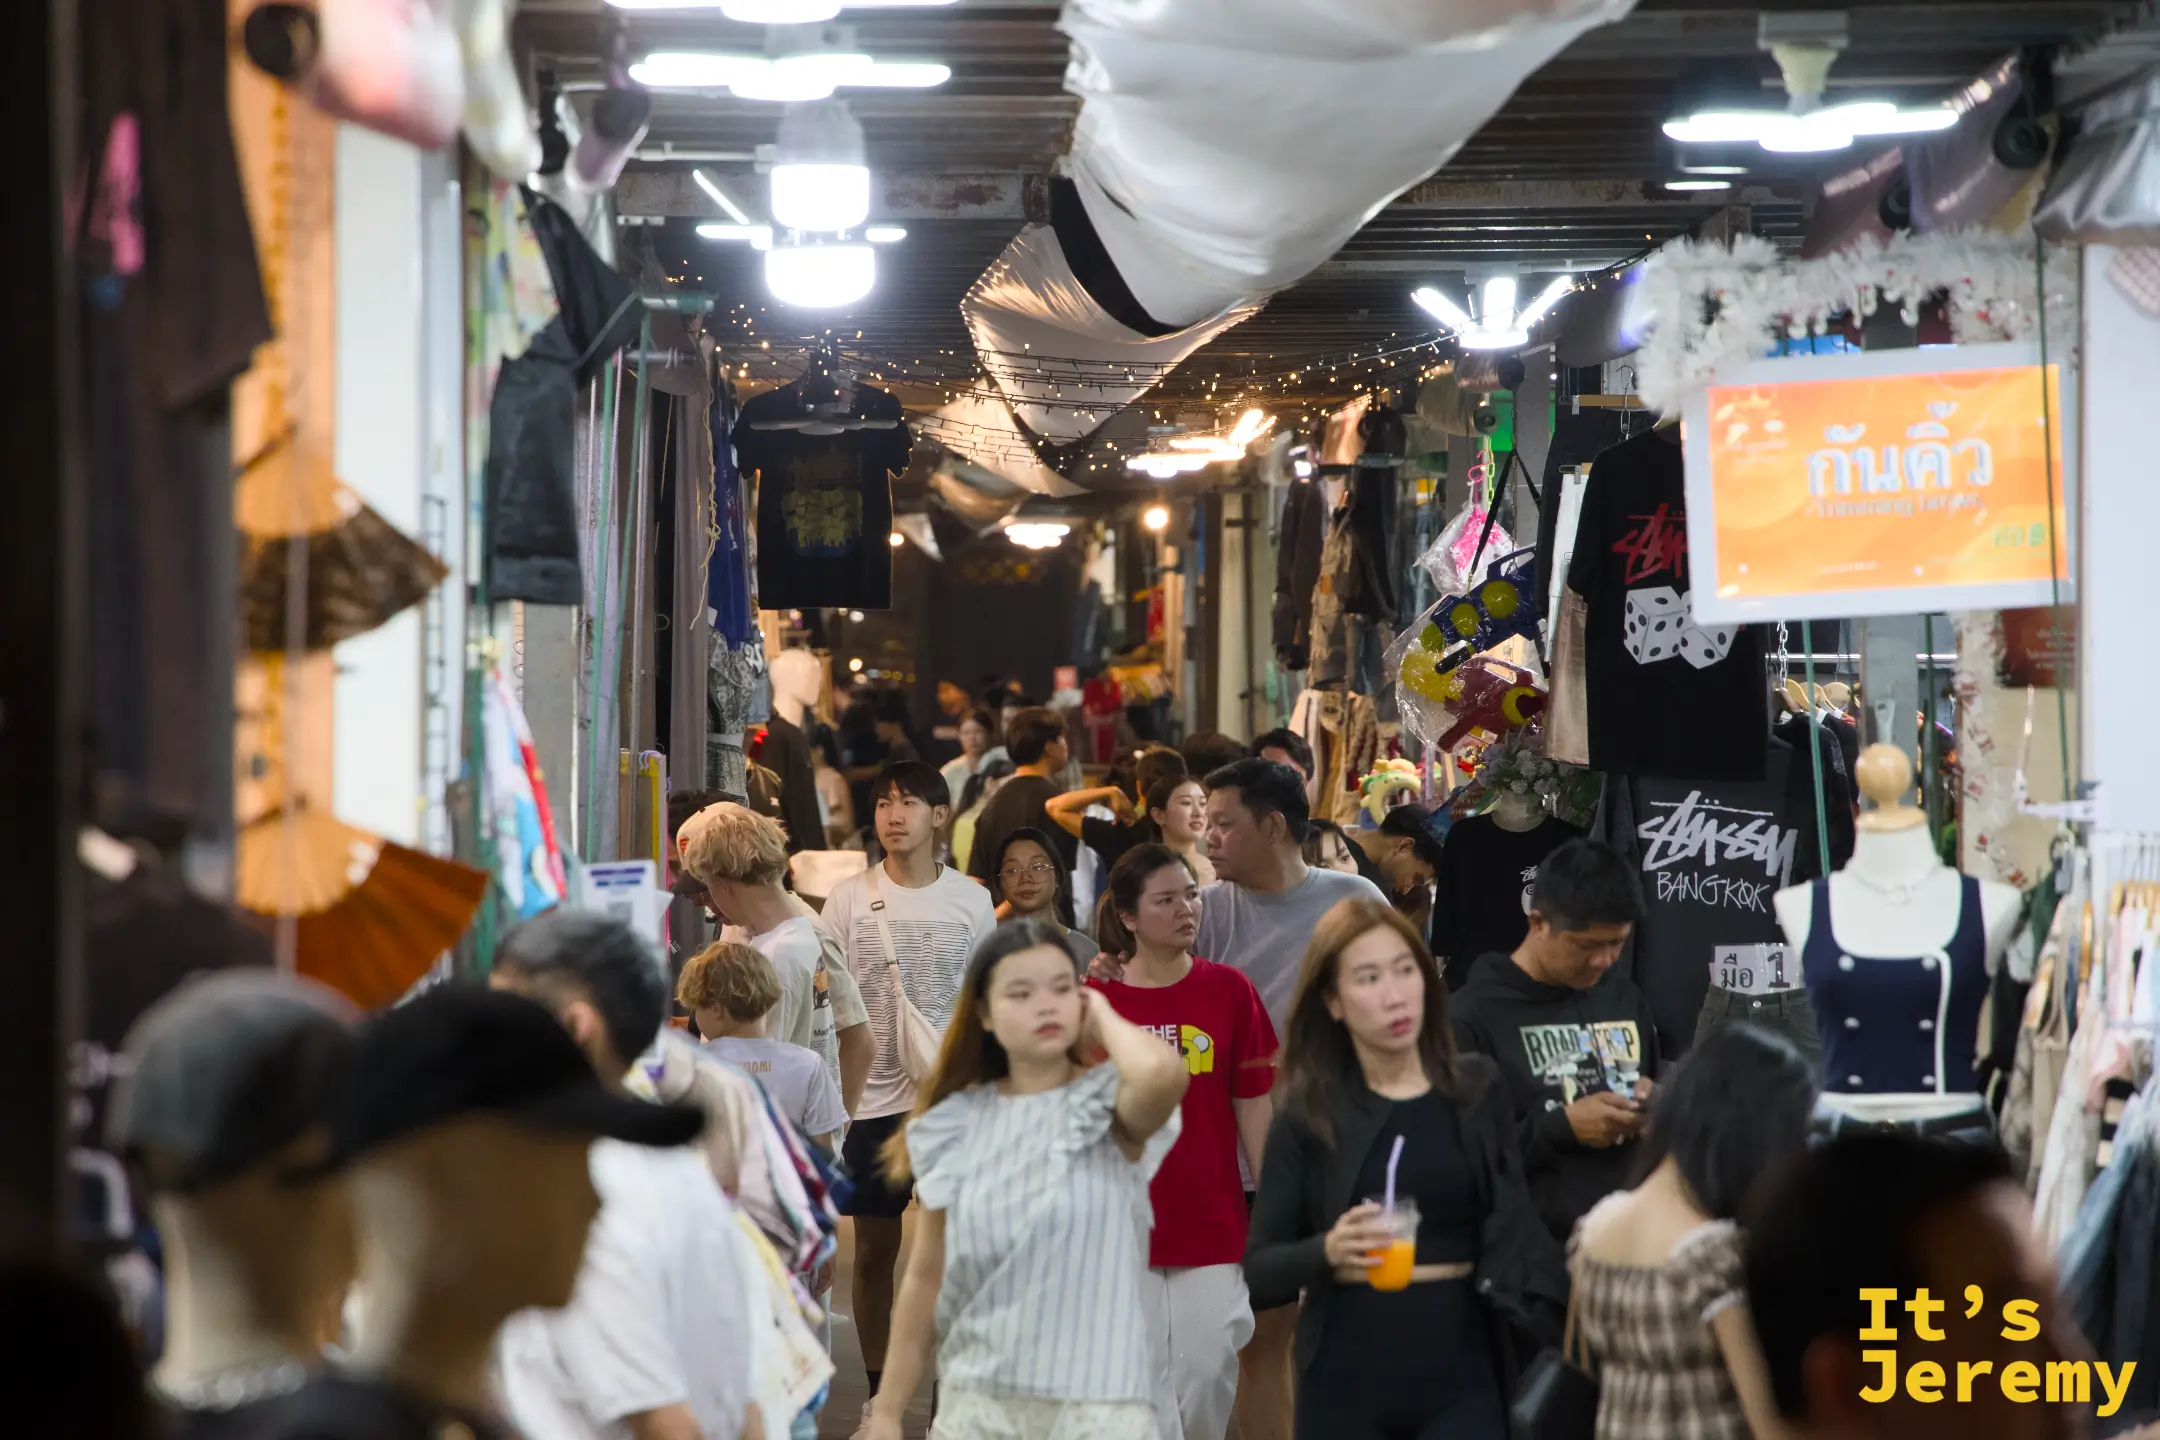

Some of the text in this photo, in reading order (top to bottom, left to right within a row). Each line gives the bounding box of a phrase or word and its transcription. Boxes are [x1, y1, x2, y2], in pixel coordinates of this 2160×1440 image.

[1806, 400, 1994, 496] กันคิ้ว
[1657, 871, 1770, 913] BANGKOK
[1720, 951, 1791, 989] มือ 1
